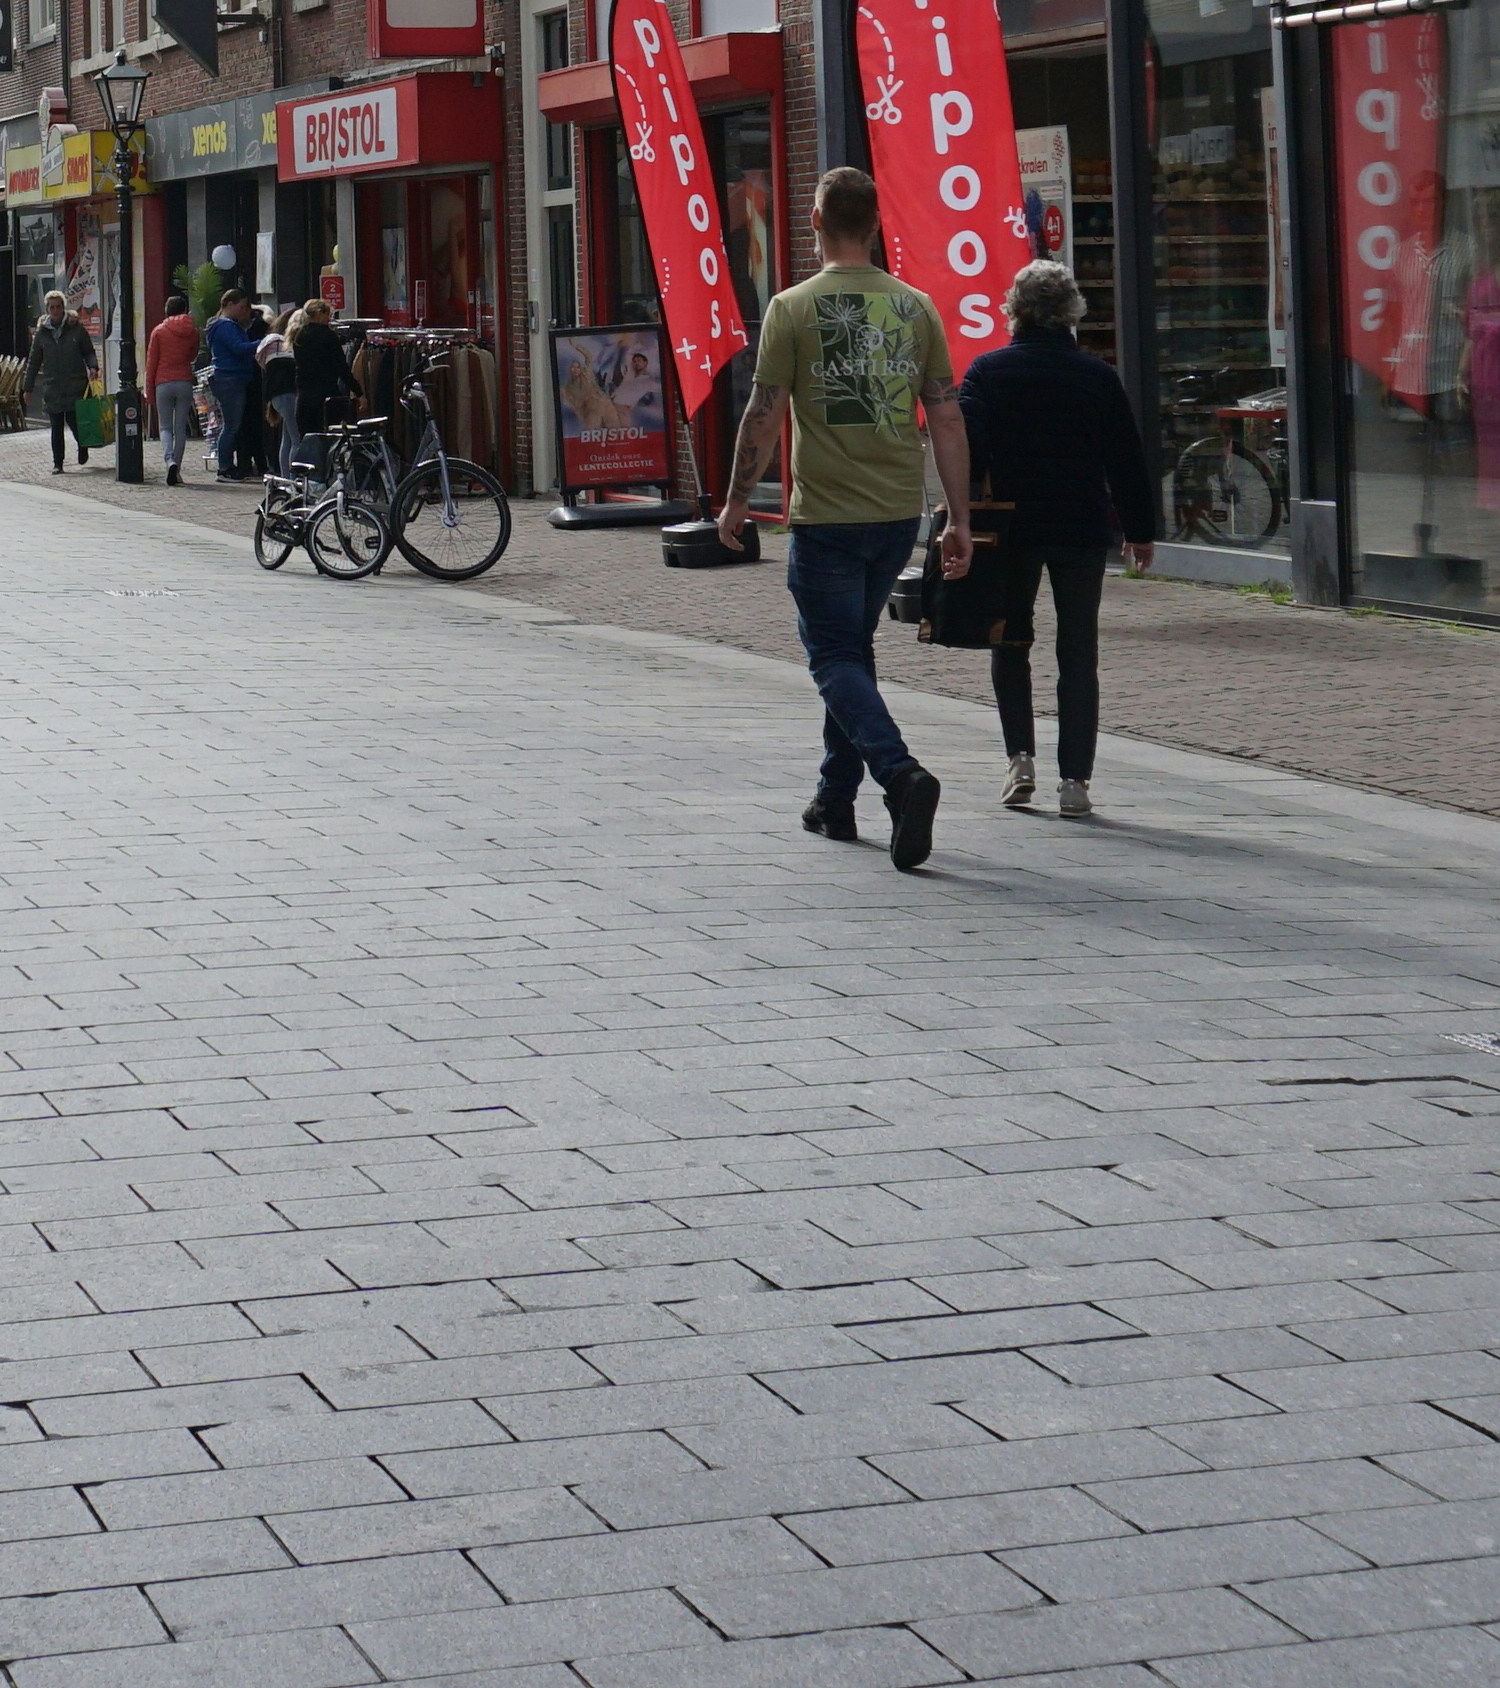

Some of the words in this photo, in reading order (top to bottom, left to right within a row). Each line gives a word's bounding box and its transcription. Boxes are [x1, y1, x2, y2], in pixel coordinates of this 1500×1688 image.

[192, 120, 227, 157] xenos
[306, 101, 385, 163] BRISTOL
[633, 18, 721, 339] pipoos
[581, 426, 648, 447] BRISTOL
